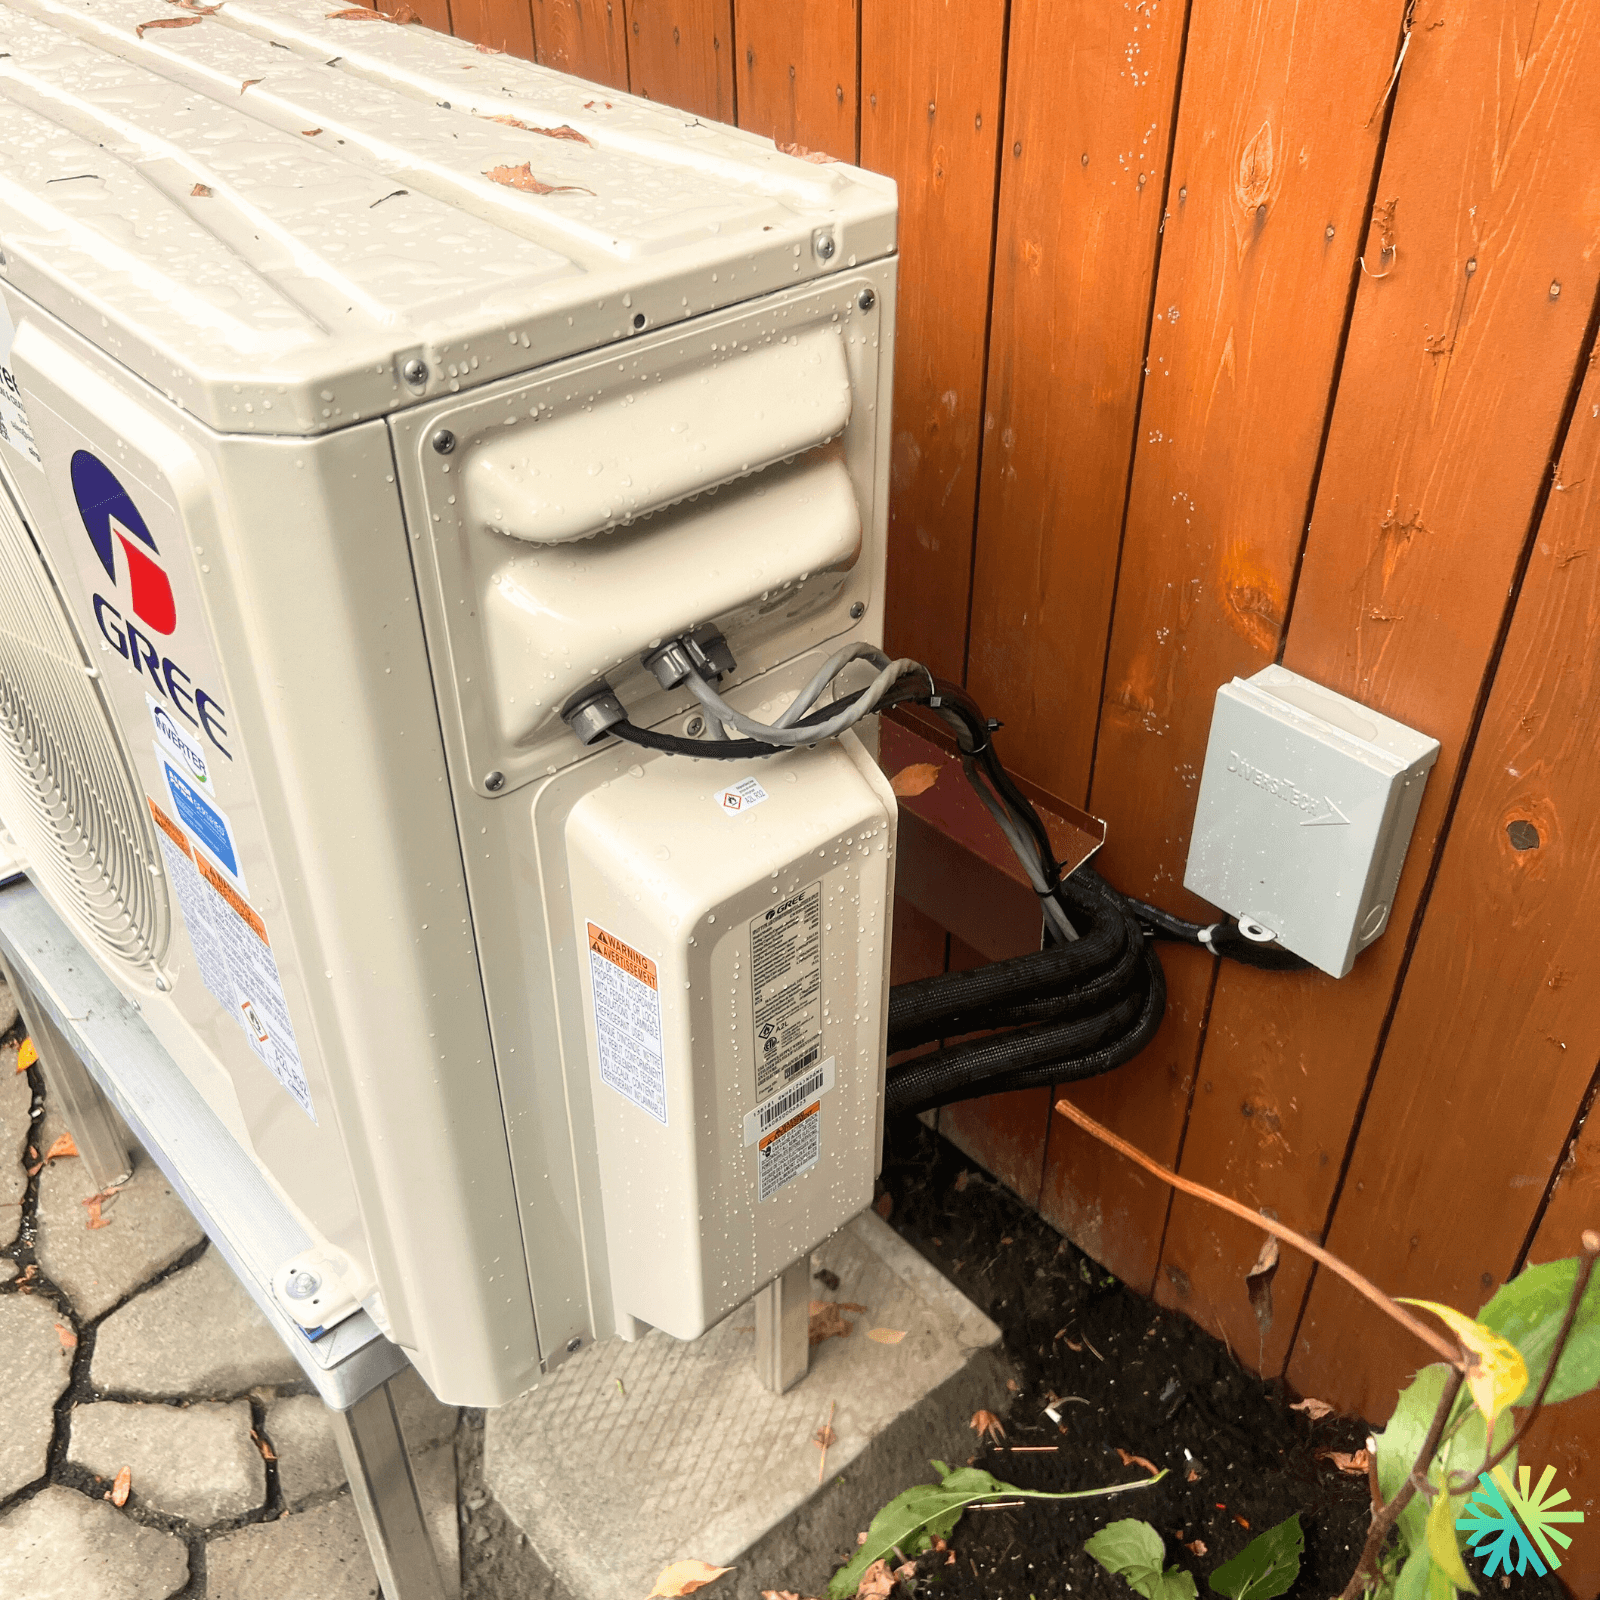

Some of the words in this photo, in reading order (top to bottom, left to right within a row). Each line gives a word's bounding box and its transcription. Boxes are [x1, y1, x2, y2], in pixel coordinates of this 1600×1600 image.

[93, 592, 234, 762] GREE
[154, 714, 207, 776] INVERTER
[776, 892, 806, 914] GREE
[603, 945, 655, 988] AVERTISSEMENT
[608, 935, 648, 970] WARNING
[592, 952, 603, 969] RISK
[605, 960, 612, 974] OF
[627, 974, 647, 997] DISPOSE
[649, 988, 656, 1002] OF
[593, 965, 617, 990] PROPERLY
[626, 986, 657, 1015] ACCORDANCE
[594, 978, 608, 995] WITH
[609, 987, 630, 1010] FEDERAL
[632, 1002, 640, 1016] OR
[642, 1008, 657, 1028] LOCAL
[597, 1002, 630, 1033] REFRIGERANT
[598, 1019, 615, 1039] RISQUE
[600, 1031, 607, 1045] AU
[630, 1012, 658, 1040] FLAMMABLE
[776, 1021, 789, 1034] A2L
